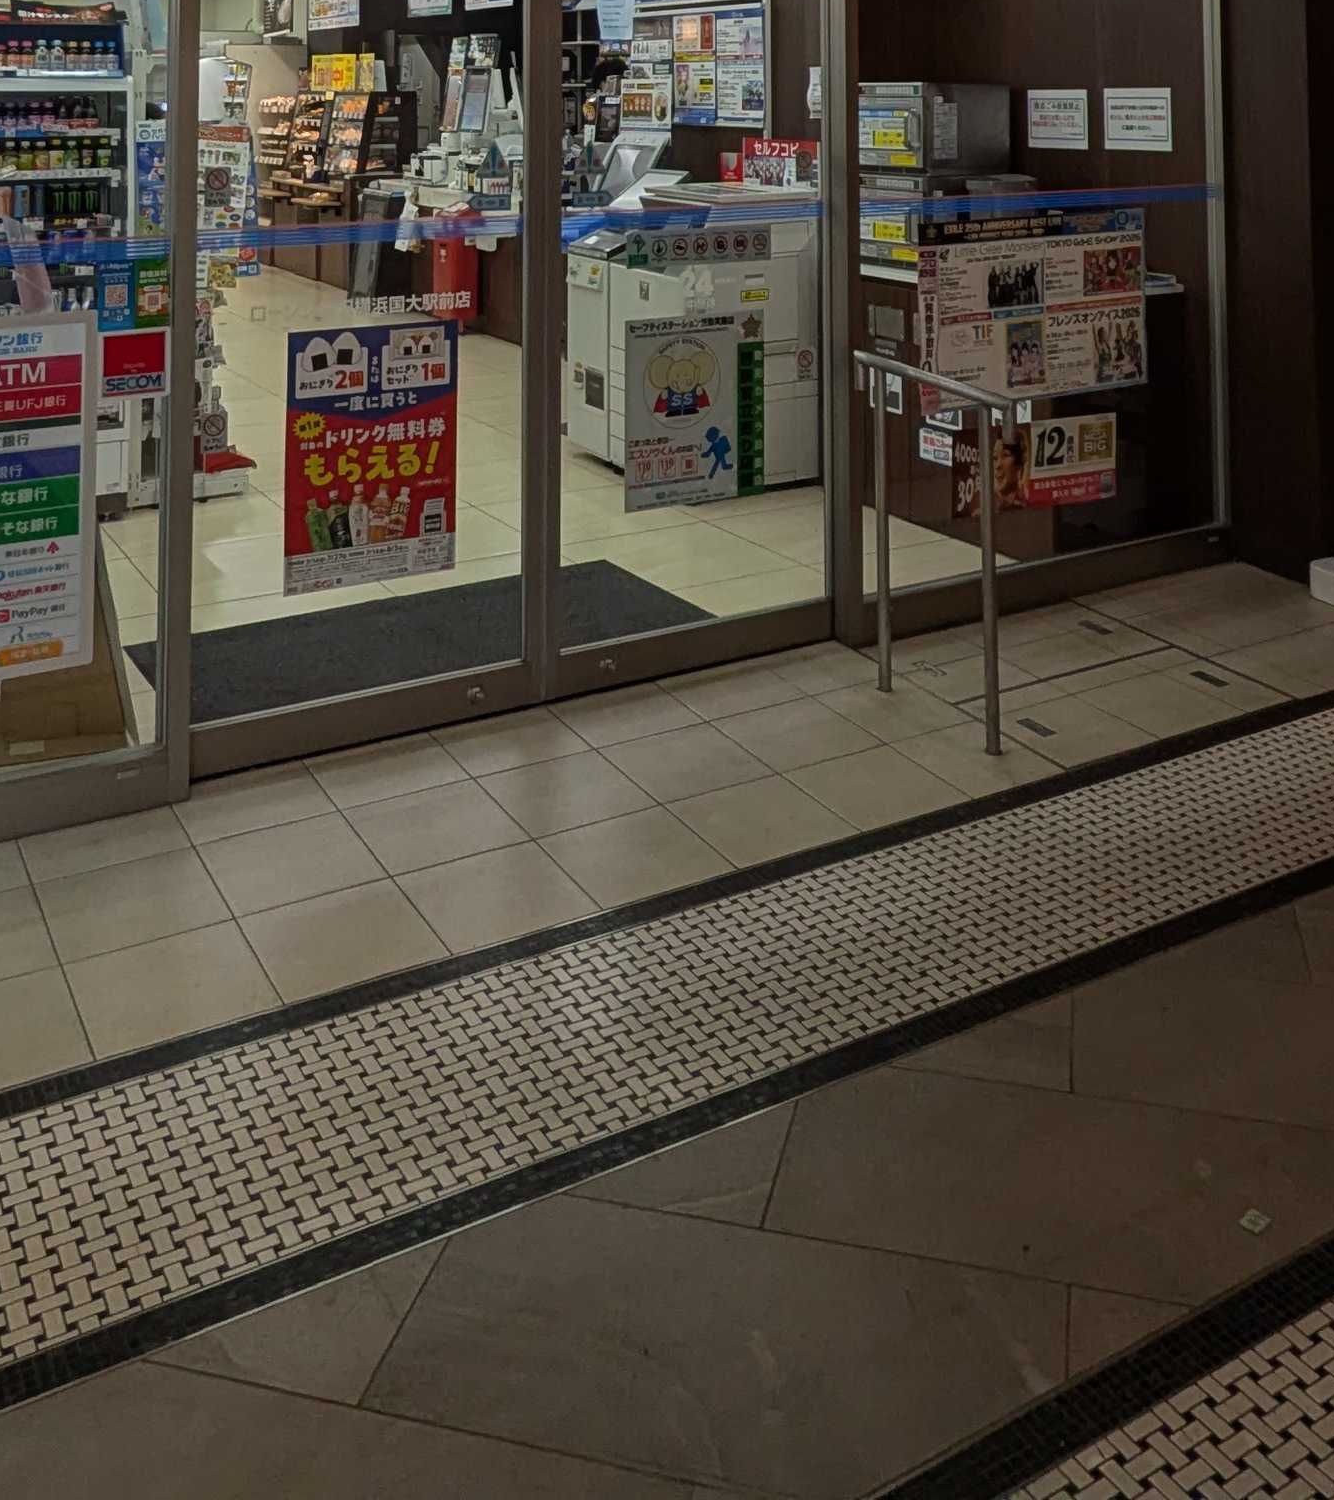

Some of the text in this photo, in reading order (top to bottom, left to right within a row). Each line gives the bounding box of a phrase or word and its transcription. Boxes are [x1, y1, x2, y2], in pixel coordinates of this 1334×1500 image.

[385, 363, 419, 376] おにぎり
[421, 362, 446, 382] 1個
[105, 372, 163, 393] SECOM
[298, 369, 365, 392] おにぎり 2個
[334, 391, 418, 413] 一度に買うと
[671, 392, 695, 407] SS
[324, 416, 447, 447] ドリンク無料券
[1033, 426, 1066, 468] 12
[1083, 439, 1108, 454] BIG
[303, 440, 440, 487] もらえる!
[10, 605, 49, 619] PayPay
